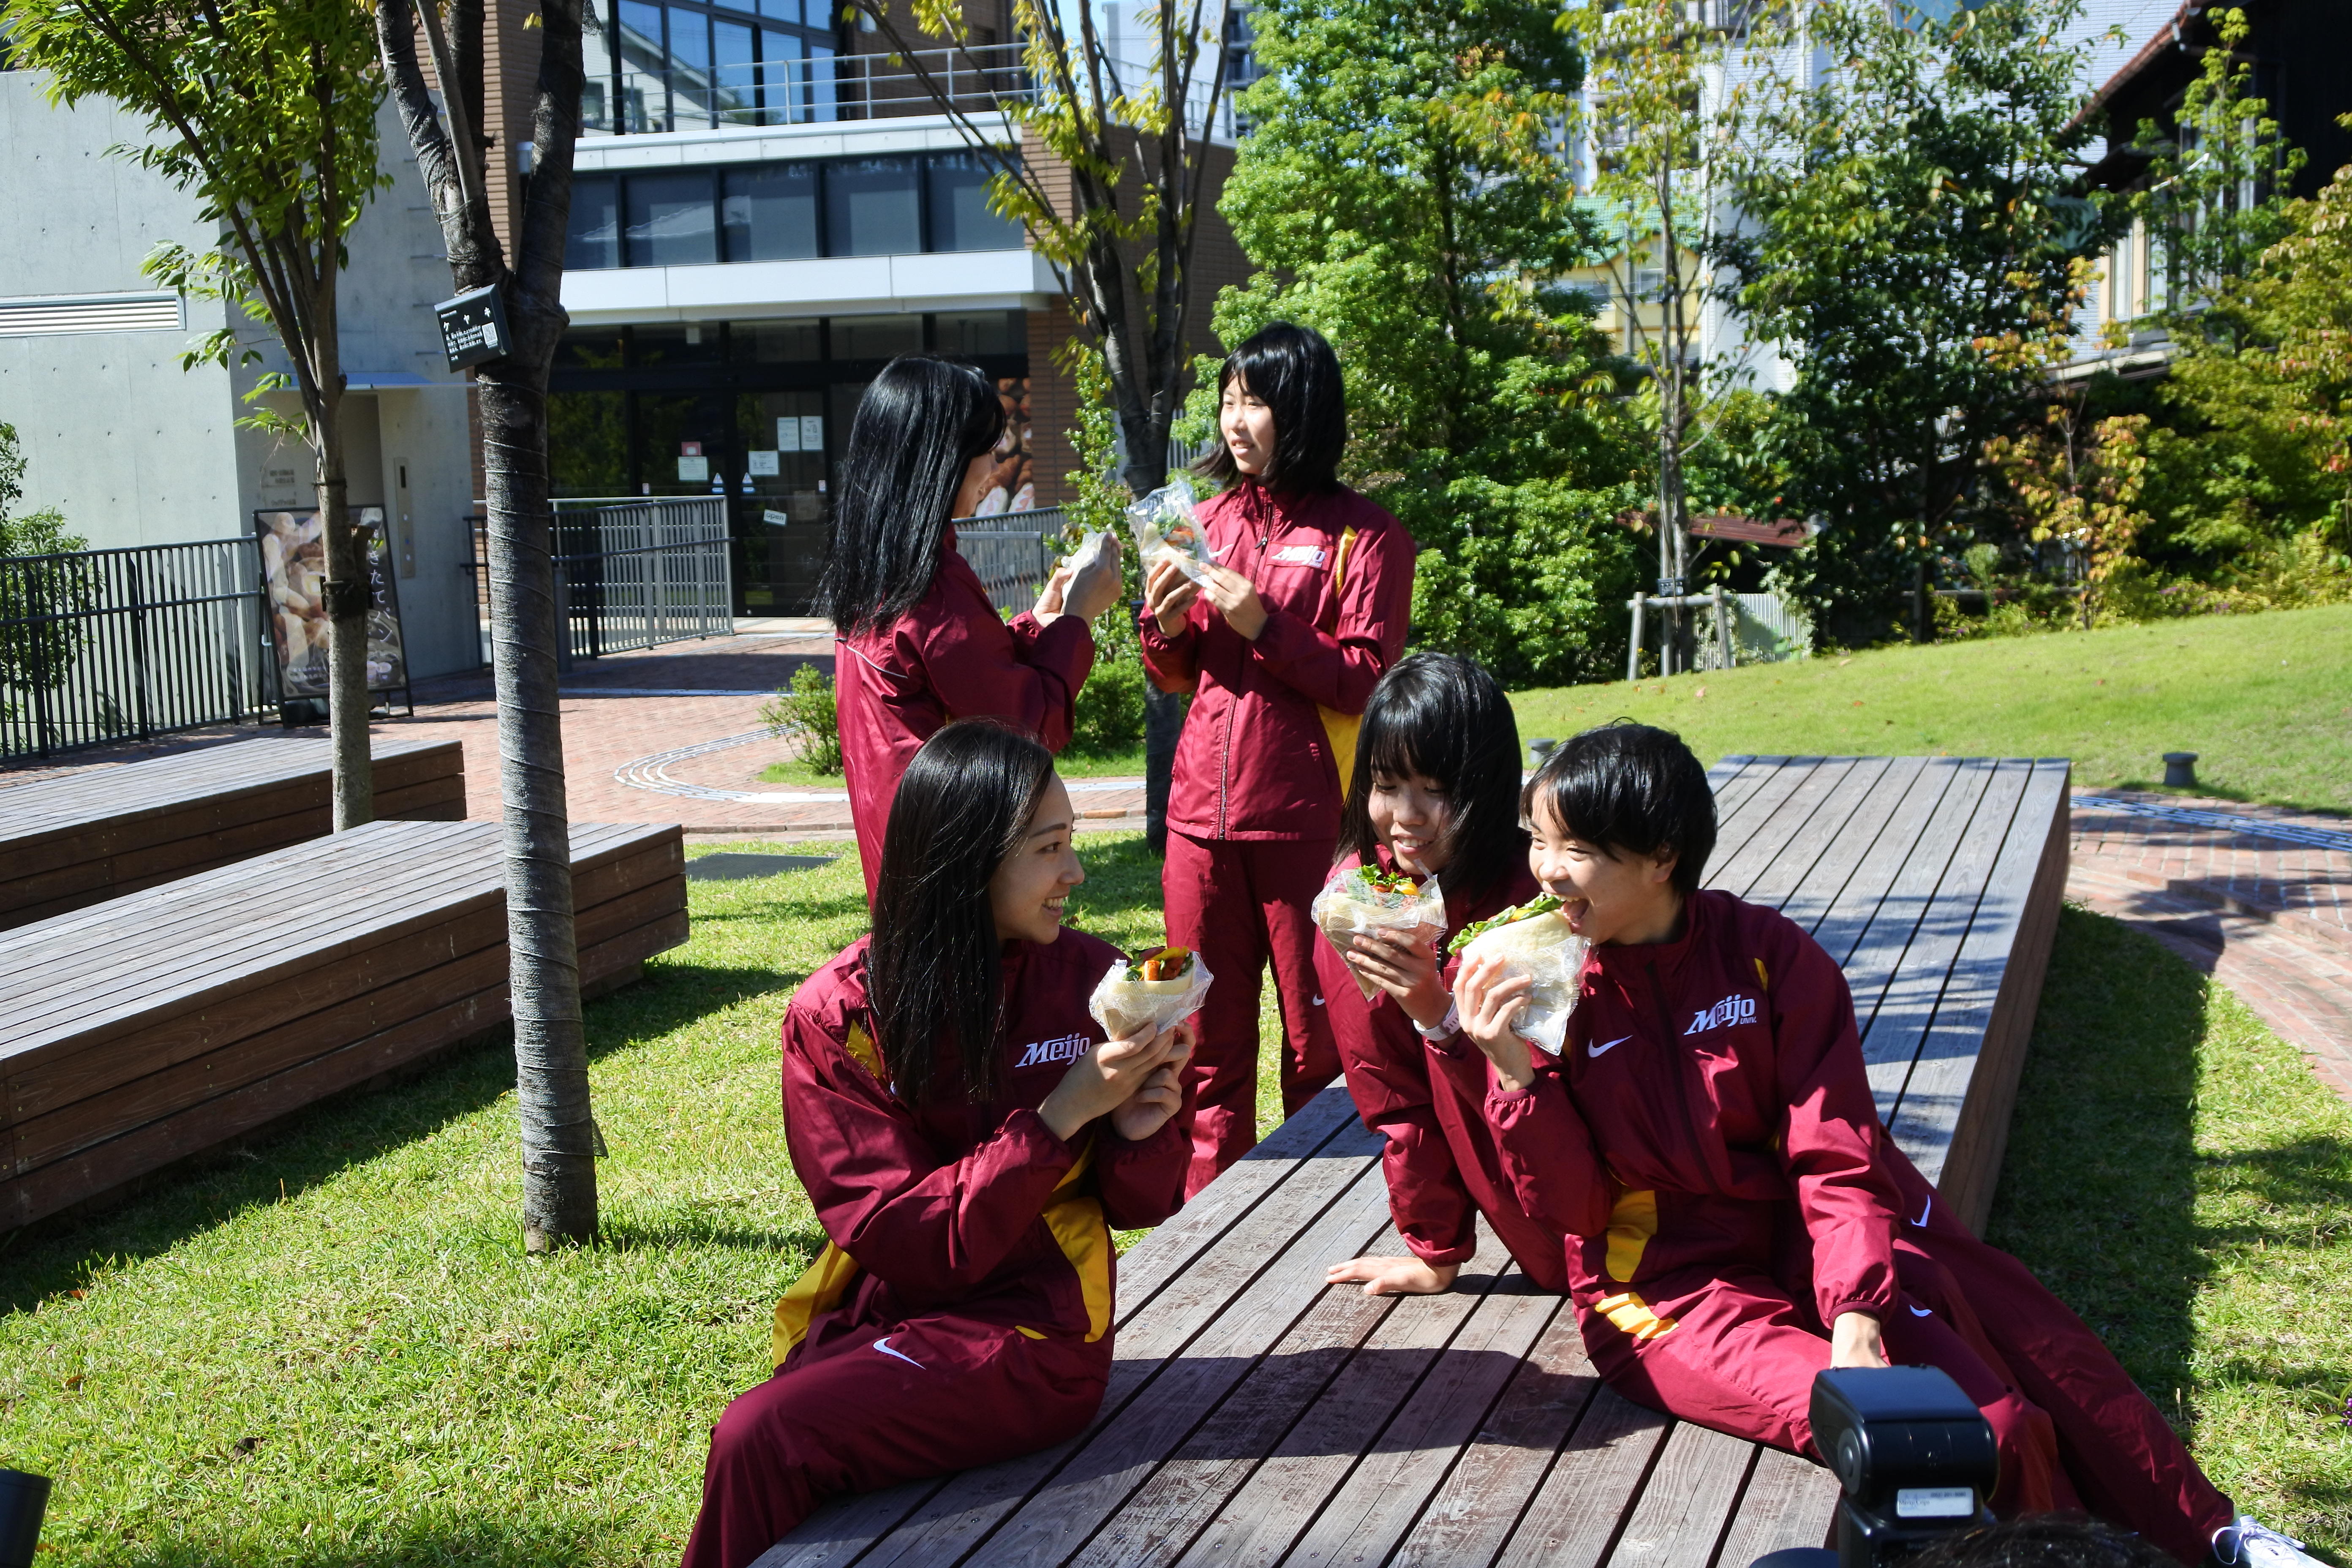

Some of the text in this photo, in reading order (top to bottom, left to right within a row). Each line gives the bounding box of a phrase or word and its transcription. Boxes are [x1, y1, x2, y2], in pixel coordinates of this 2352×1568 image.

[443, 307, 491, 332] ケヤキ
[1271, 545, 1326, 565] Meijo
[1683, 994, 1756, 1035] Meijo
[1740, 1016, 1757, 1024] UNIV.
[1015, 1033, 1090, 1068] Meijo
